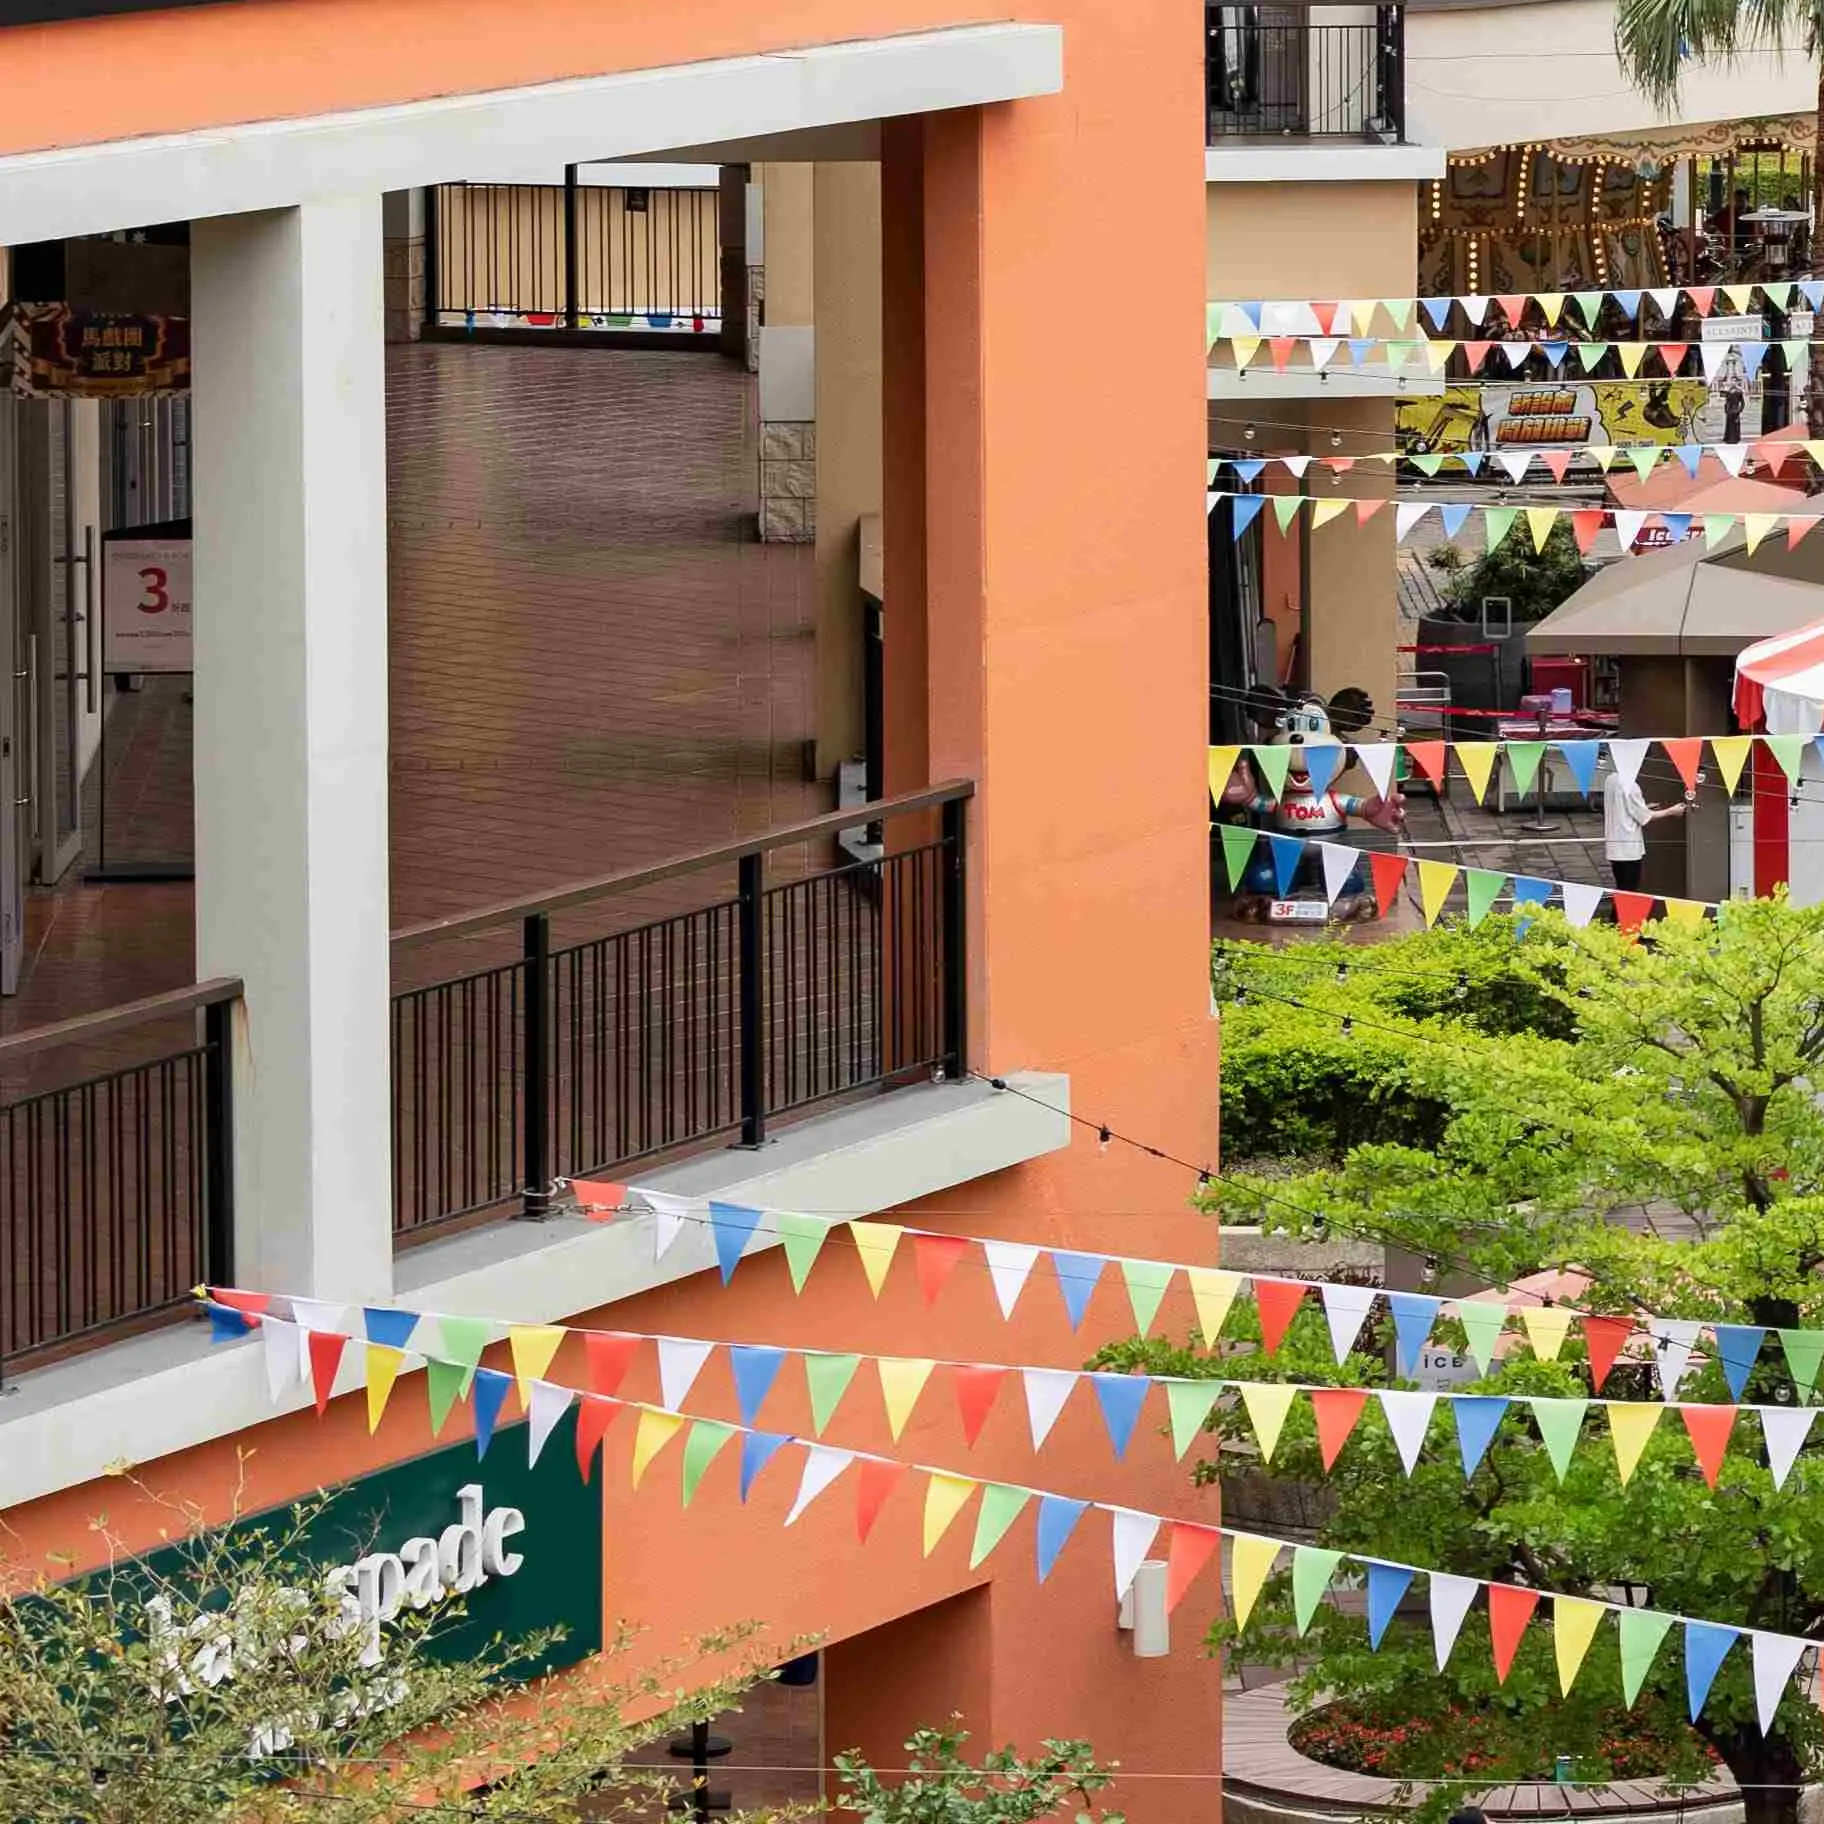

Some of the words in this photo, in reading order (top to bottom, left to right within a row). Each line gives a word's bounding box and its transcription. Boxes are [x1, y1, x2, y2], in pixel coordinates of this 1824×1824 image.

[136, 566, 170, 615] 3
[1283, 803, 1326, 820] TOM
[1274, 903, 1295, 916] 3F
[325, 1484, 526, 1667] spade
